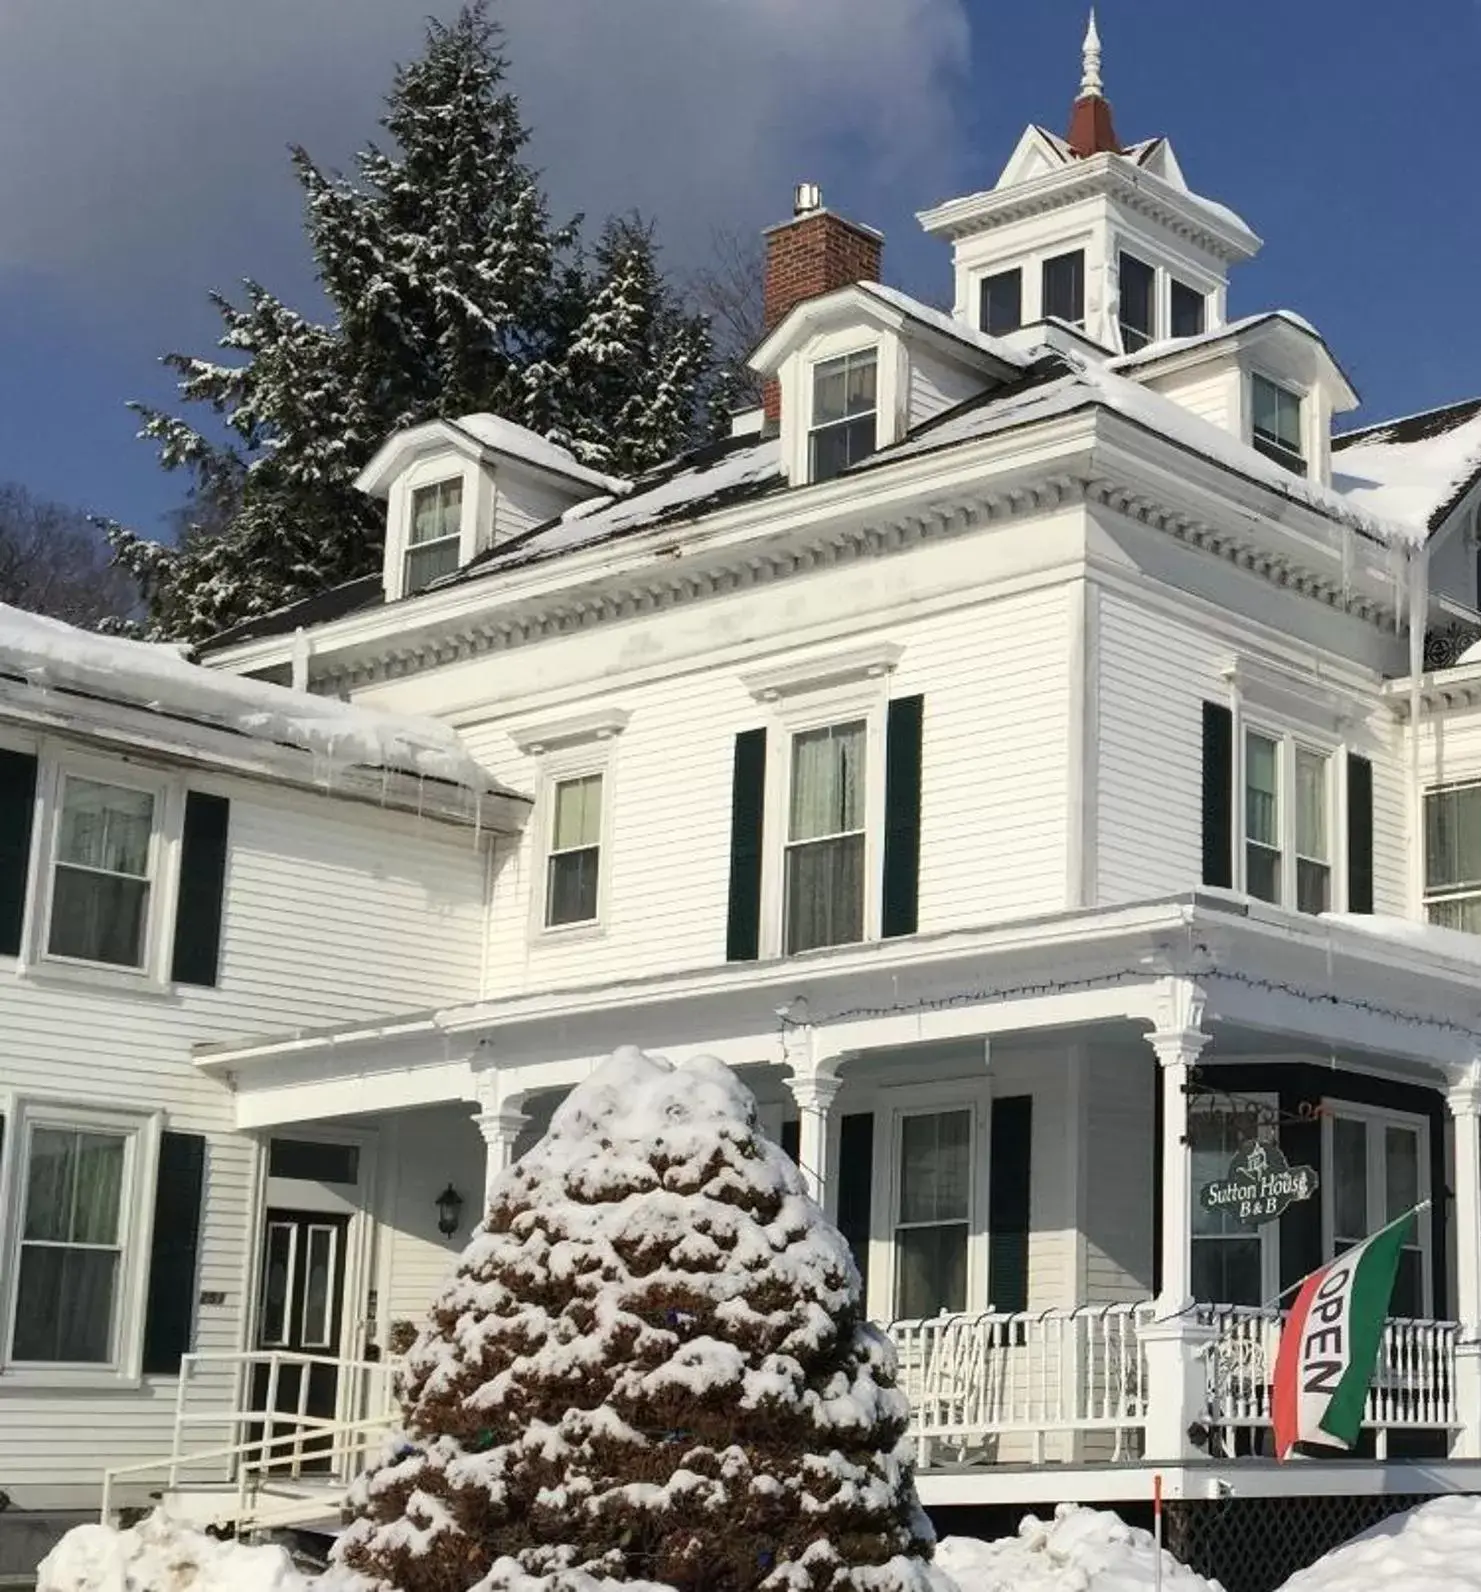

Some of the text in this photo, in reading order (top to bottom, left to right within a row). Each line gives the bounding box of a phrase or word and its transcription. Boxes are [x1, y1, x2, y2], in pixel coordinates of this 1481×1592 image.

[1208, 1183, 1256, 1205] Sutton
[1240, 1198, 1277, 1217] B & B
[1304, 1268, 1350, 1394] OPEN
